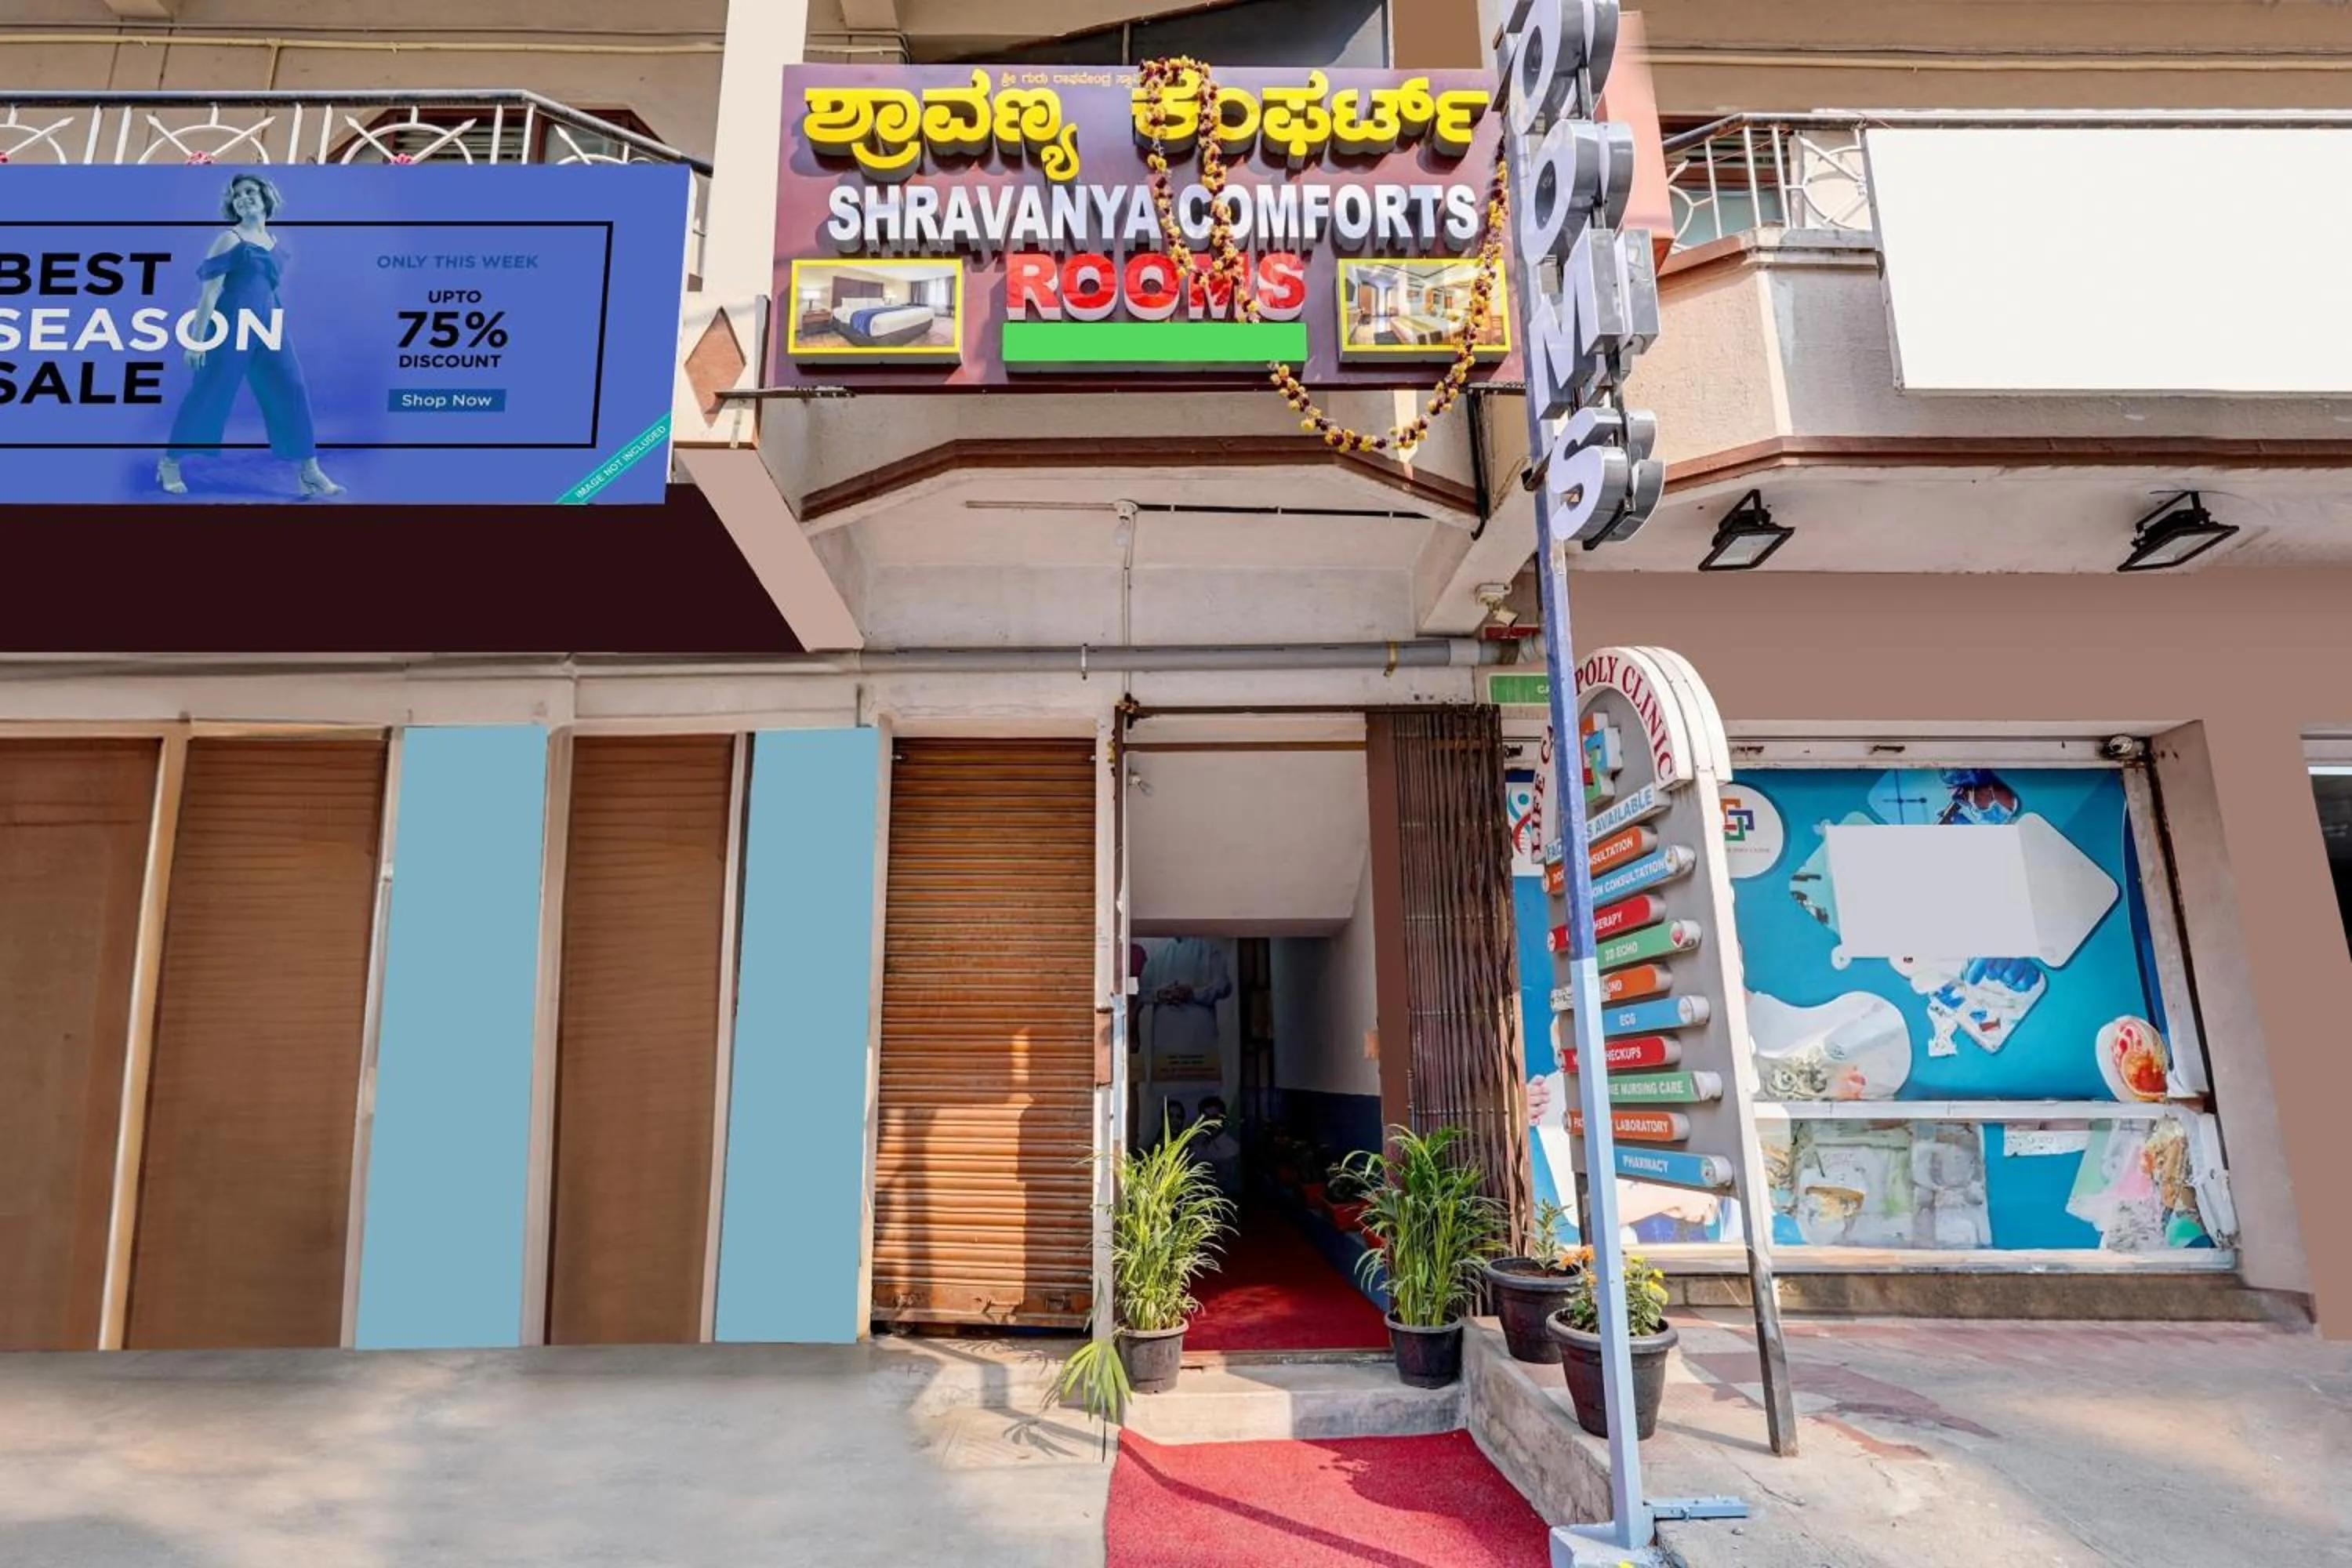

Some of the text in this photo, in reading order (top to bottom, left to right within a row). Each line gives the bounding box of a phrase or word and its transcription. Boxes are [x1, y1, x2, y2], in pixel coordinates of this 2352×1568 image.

[827, 184, 1478, 241] SHRAVANYA COMFORTS
[0, 252, 171, 296] BEST
[376, 255, 539, 269] ONLY THIS WEEK
[428, 290, 482, 303] UPTO
[1005, 252, 1305, 315] ROOMS
[397, 311, 508, 348] 75%
[398, 354, 502, 368] DISCOUNT
[401, 394, 492, 408] Shop Now
[575, 426, 666, 498] IMAGE NOT INCLUDED
[1531, 655, 1673, 854] LIFE POLY CLINIC
[1595, 789, 1653, 835] AVAILABLE
[1659, 1080, 1684, 1094] CARE
[1615, 1119, 1669, 1134] LABORATORY
[1622, 1155, 1669, 1174] PHARMACY
